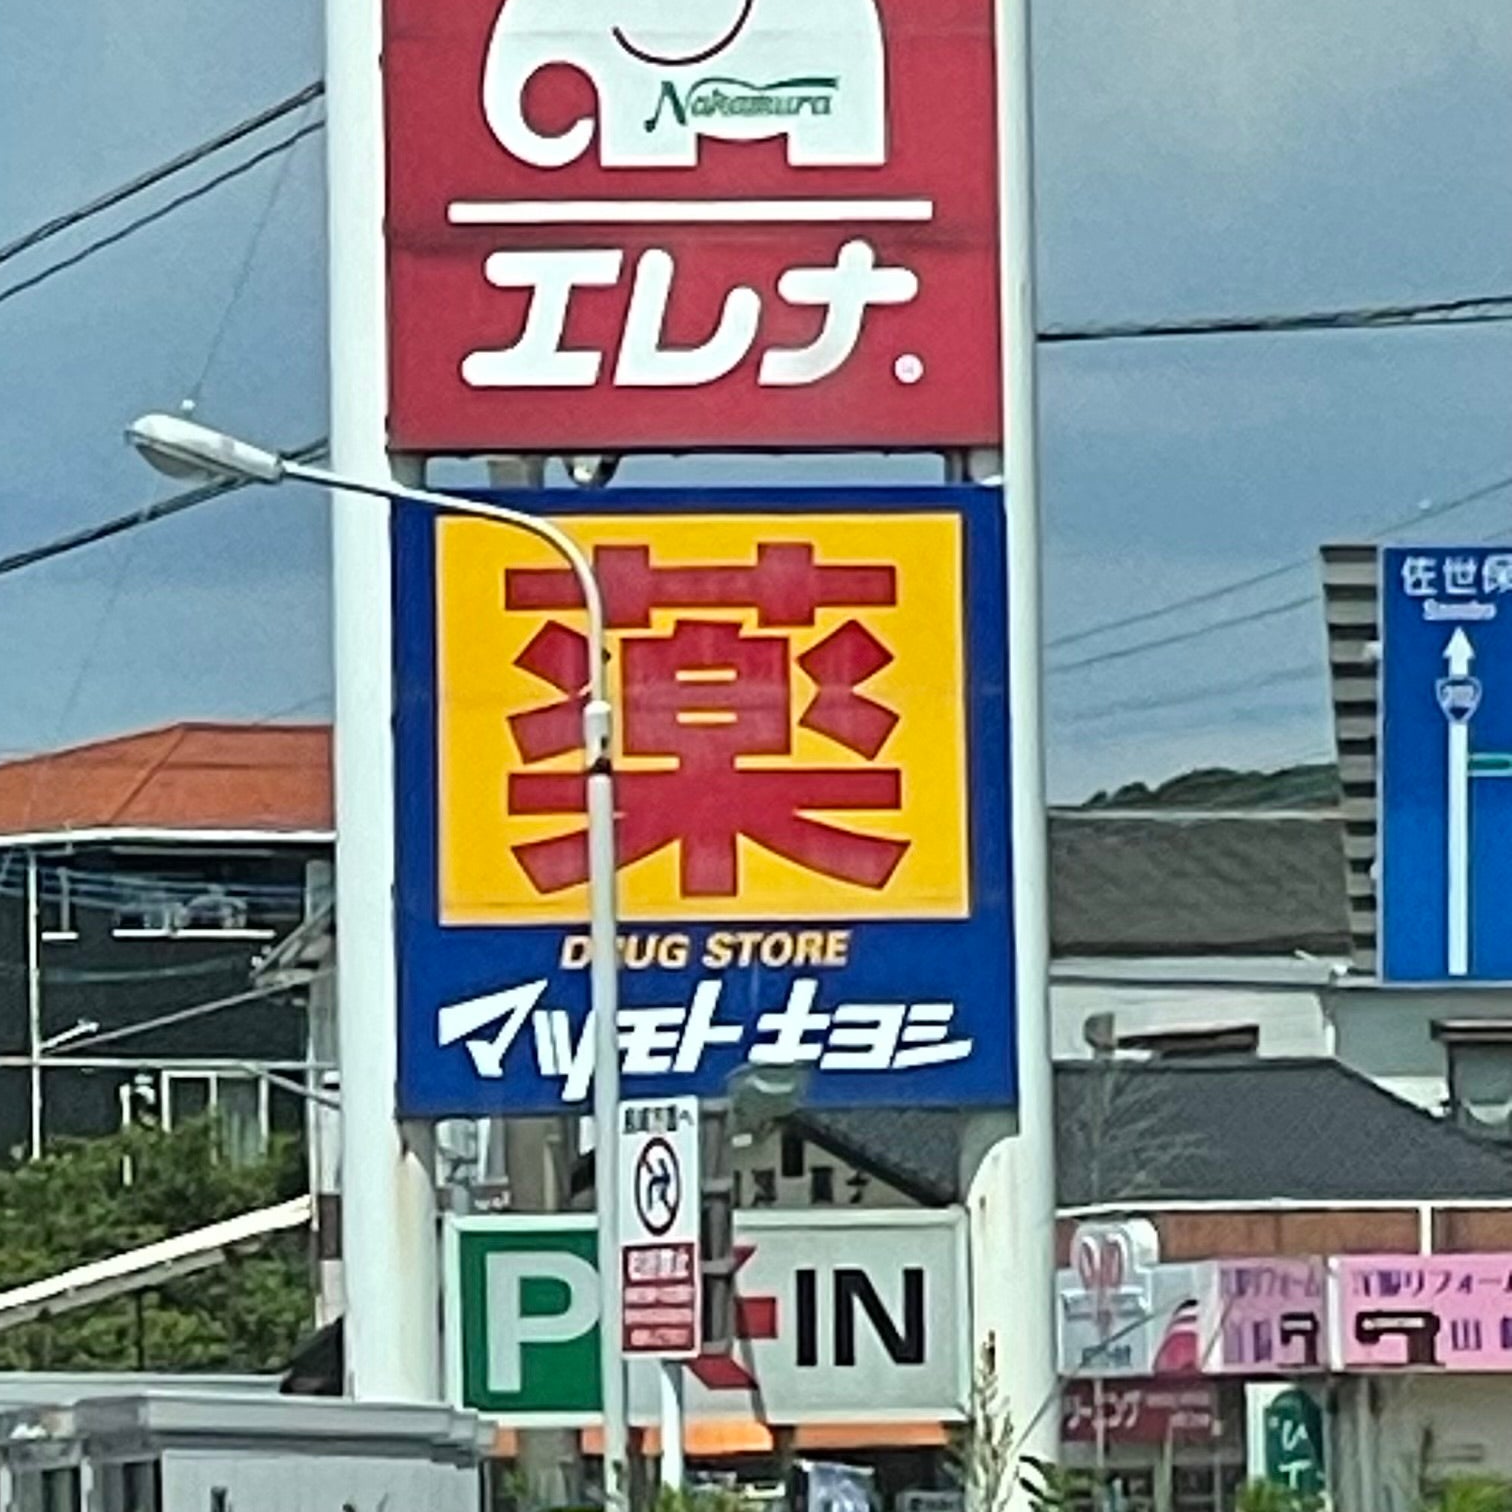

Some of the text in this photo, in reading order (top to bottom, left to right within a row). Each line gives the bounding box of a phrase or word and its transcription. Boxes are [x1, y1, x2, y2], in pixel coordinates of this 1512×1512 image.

[644, 76, 839, 133] Nakamura
[461, 240, 920, 387] エレナ
[505, 542, 912, 898] 薬
[560, 930, 854, 970] DUG STORE
[488, 1251, 925, 1393] P IN
